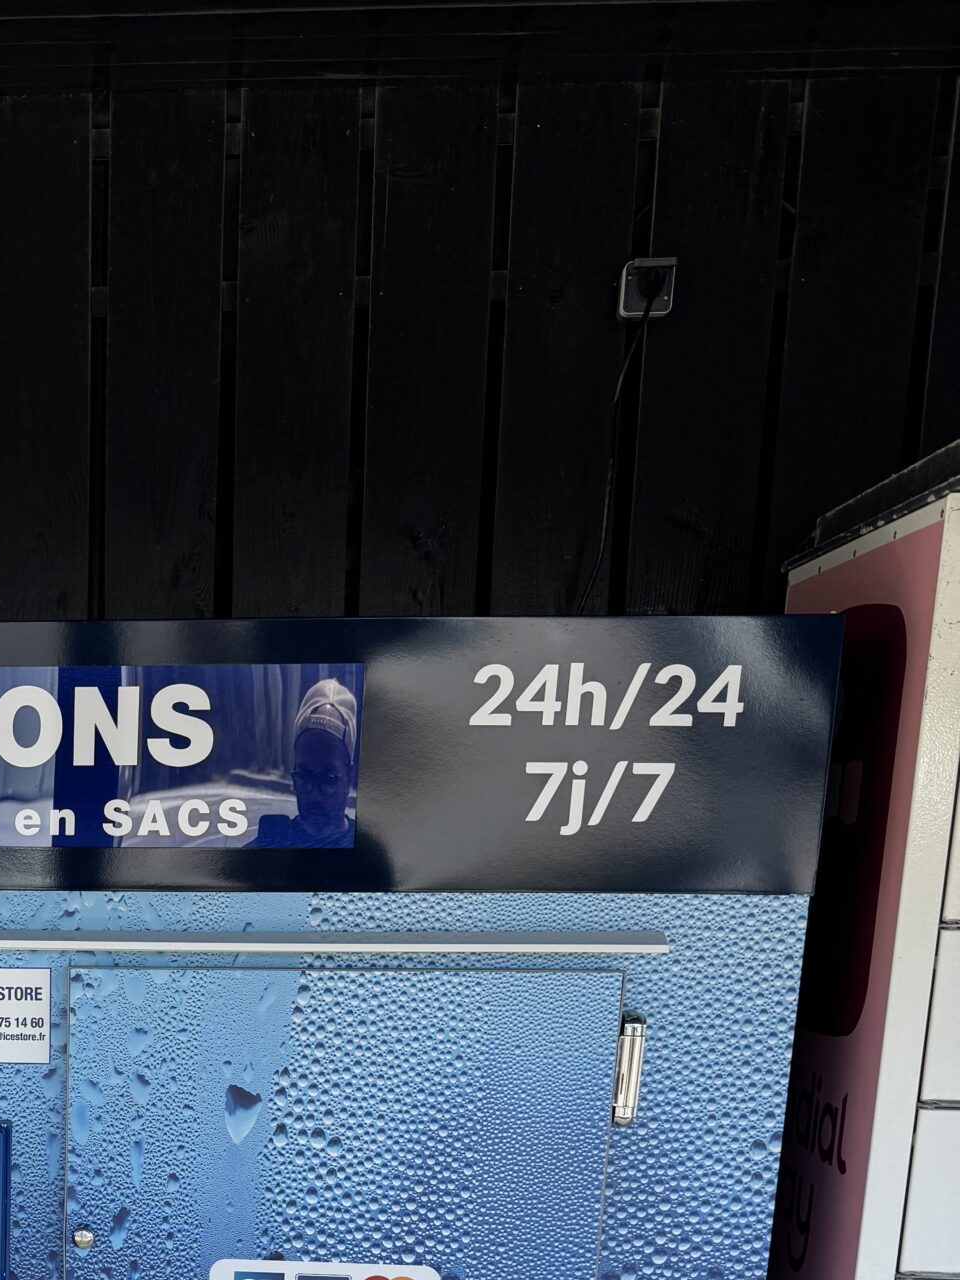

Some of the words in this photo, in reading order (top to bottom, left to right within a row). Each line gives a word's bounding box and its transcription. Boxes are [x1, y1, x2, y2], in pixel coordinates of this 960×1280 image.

[468, 662, 745, 730] 24h/24
[15, 809, 76, 837] en
[104, 798, 249, 837] SACS
[525, 761, 676, 837] 7j/7
[15, 1017, 28, 1028] 14
[31, 1017, 44, 1028] 60
